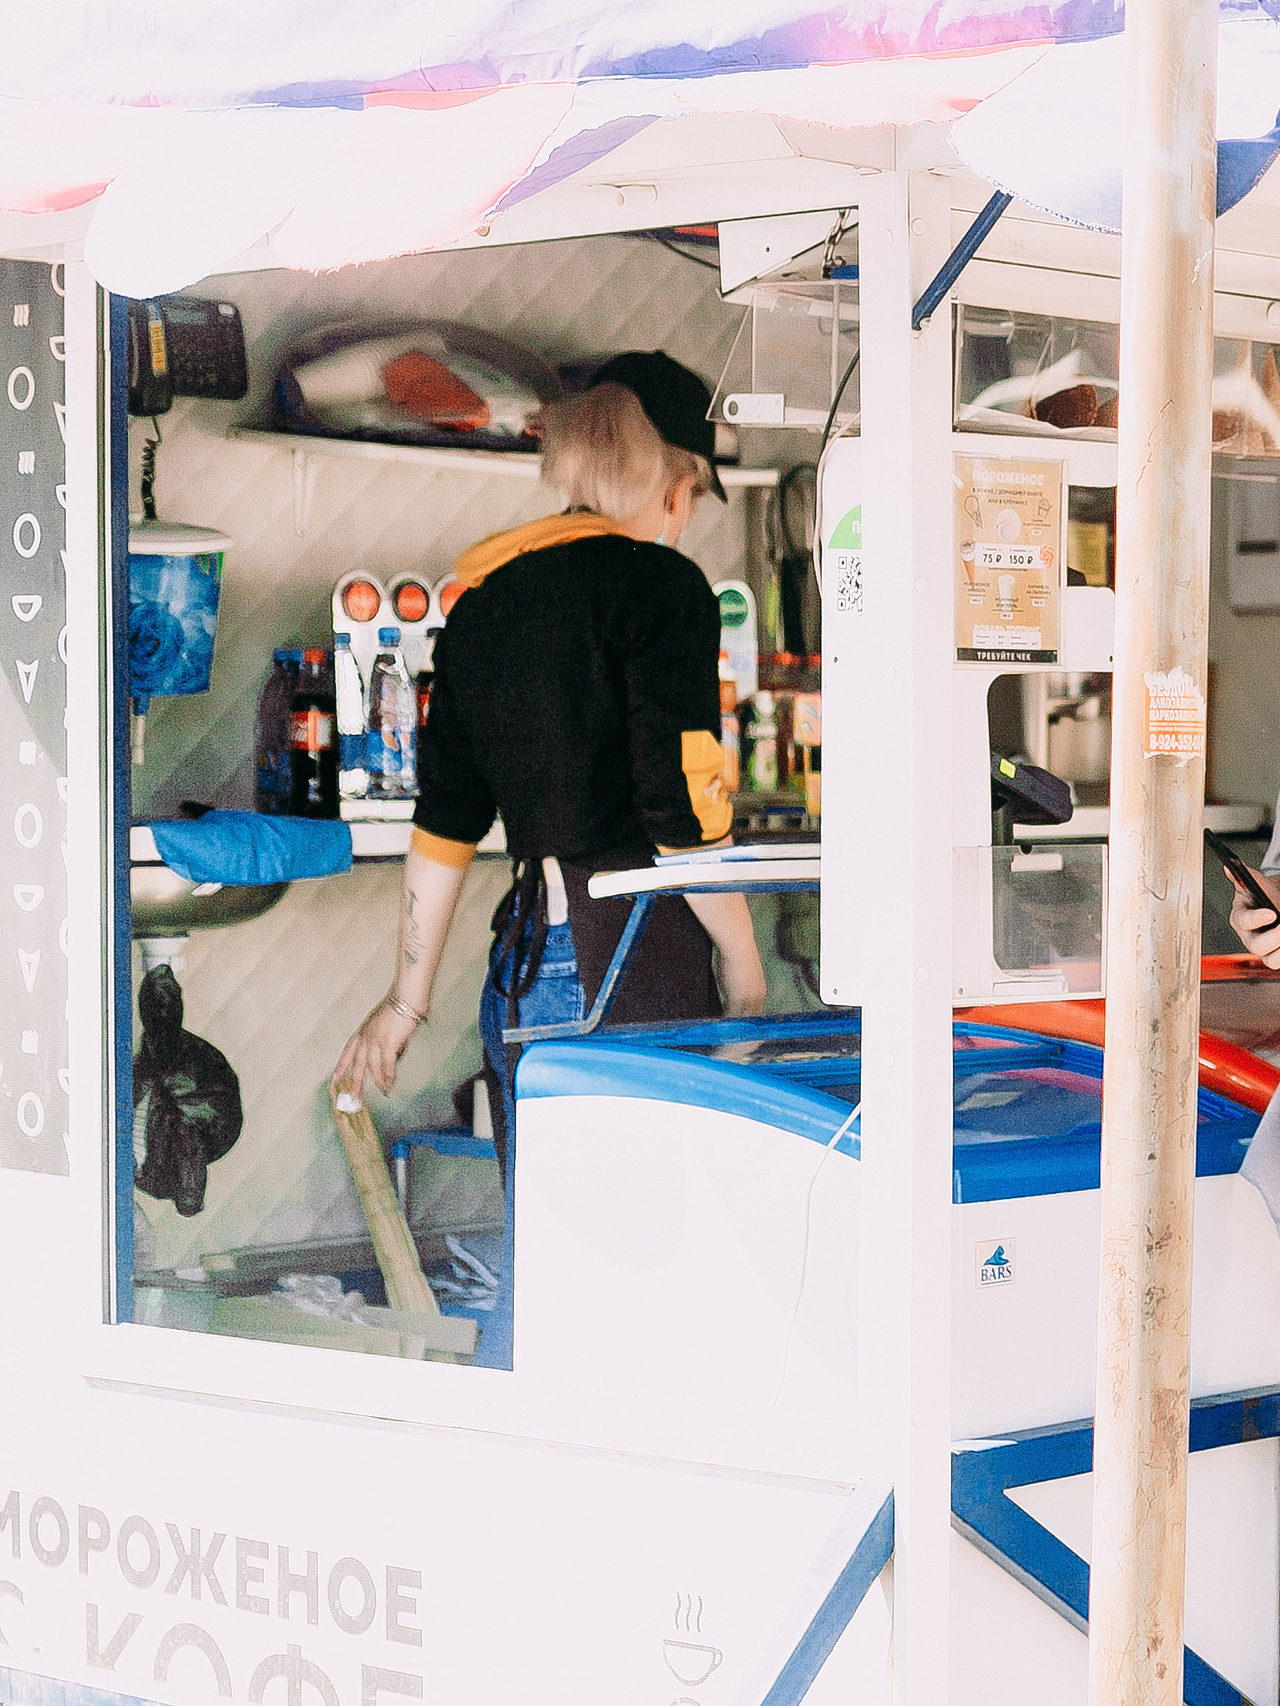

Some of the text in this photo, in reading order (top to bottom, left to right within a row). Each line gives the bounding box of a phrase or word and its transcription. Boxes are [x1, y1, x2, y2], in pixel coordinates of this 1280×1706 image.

[972, 470, 1044, 486] МОРОЖЕНОЕ
[982, 553, 993, 563] 75
[1009, 554, 1024, 565] 150
[976, 651, 1032, 661] ТРЕБУЙТЕ ЧЕК
[981, 1265, 1012, 1282] BARS
